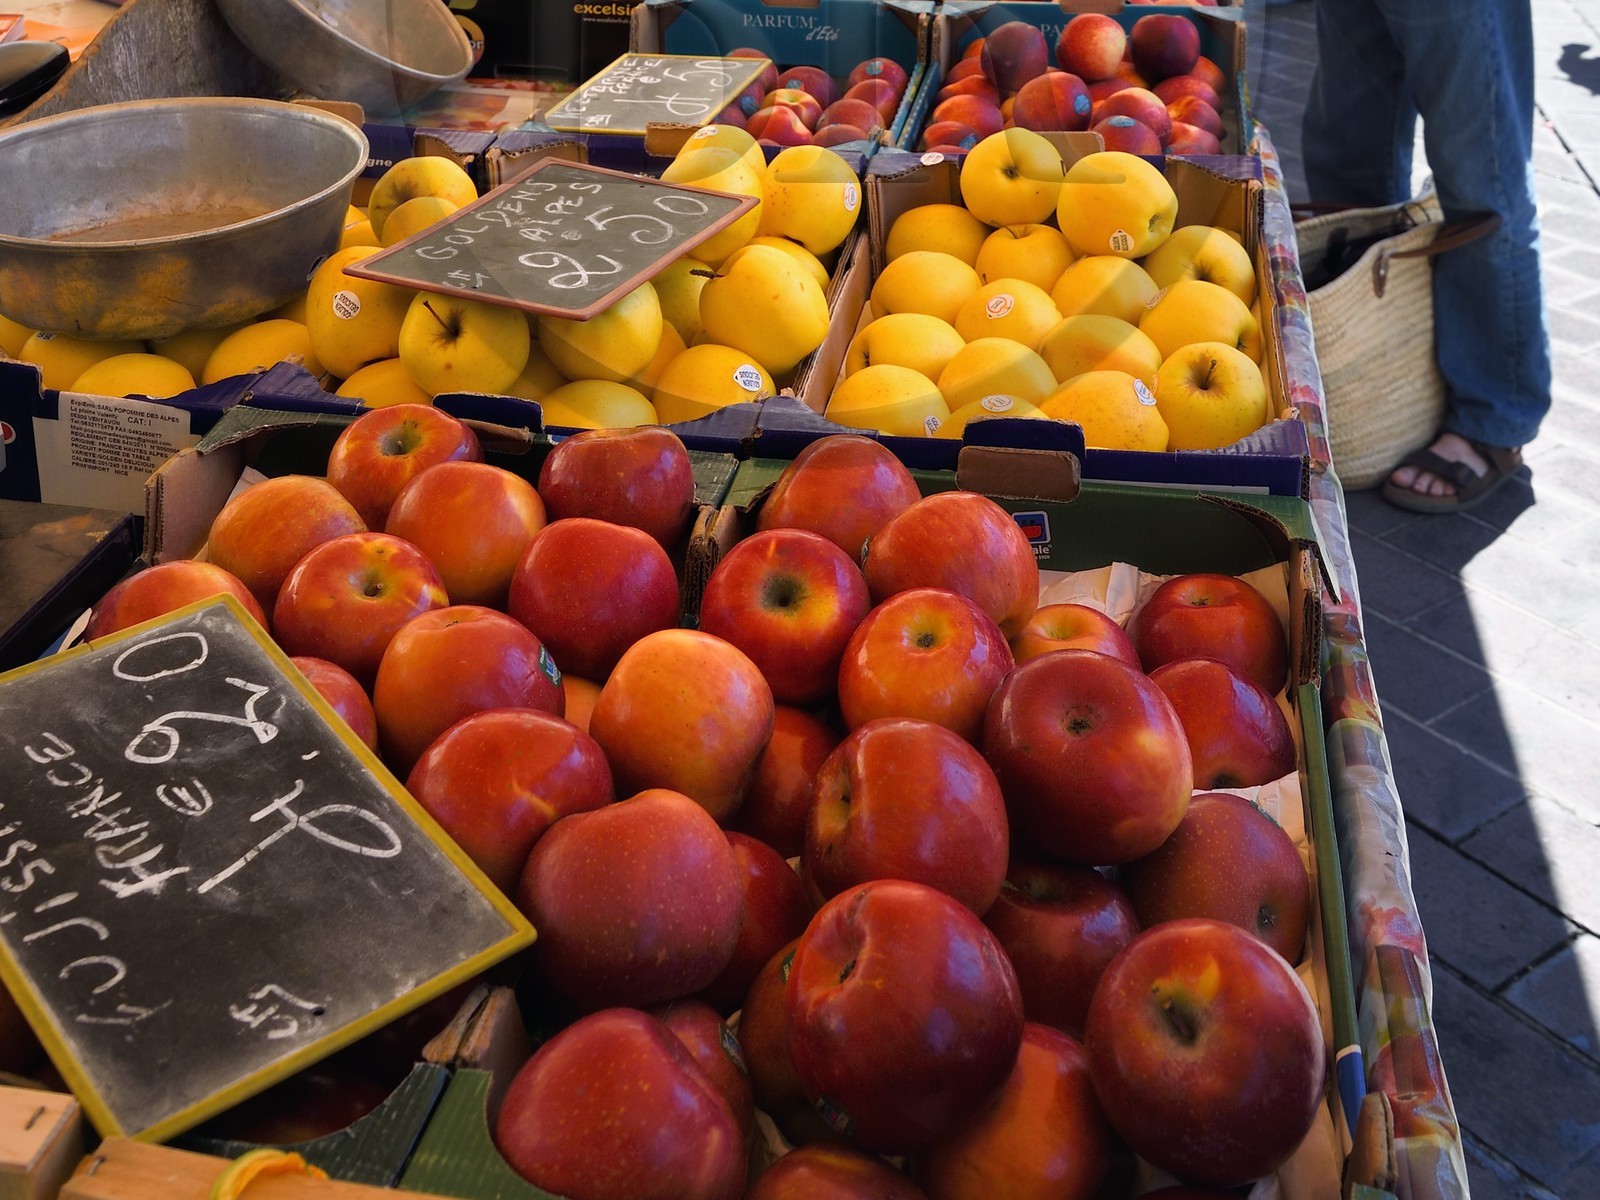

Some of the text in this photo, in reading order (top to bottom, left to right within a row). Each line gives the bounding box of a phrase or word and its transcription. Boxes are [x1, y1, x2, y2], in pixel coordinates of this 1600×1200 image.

[339, 293, 360, 313] DELICIOUS
[160, 414, 180, 423] ALPES
[98, 442, 122, 450] FRANCE
[123, 446, 148, 455] HAUTES
[149, 450, 168, 458] ALPES
[123, 459, 155, 468] DELICIOUS
[1032, 545, 1050, 554] ale
[24, 731, 190, 898] FRANCE
